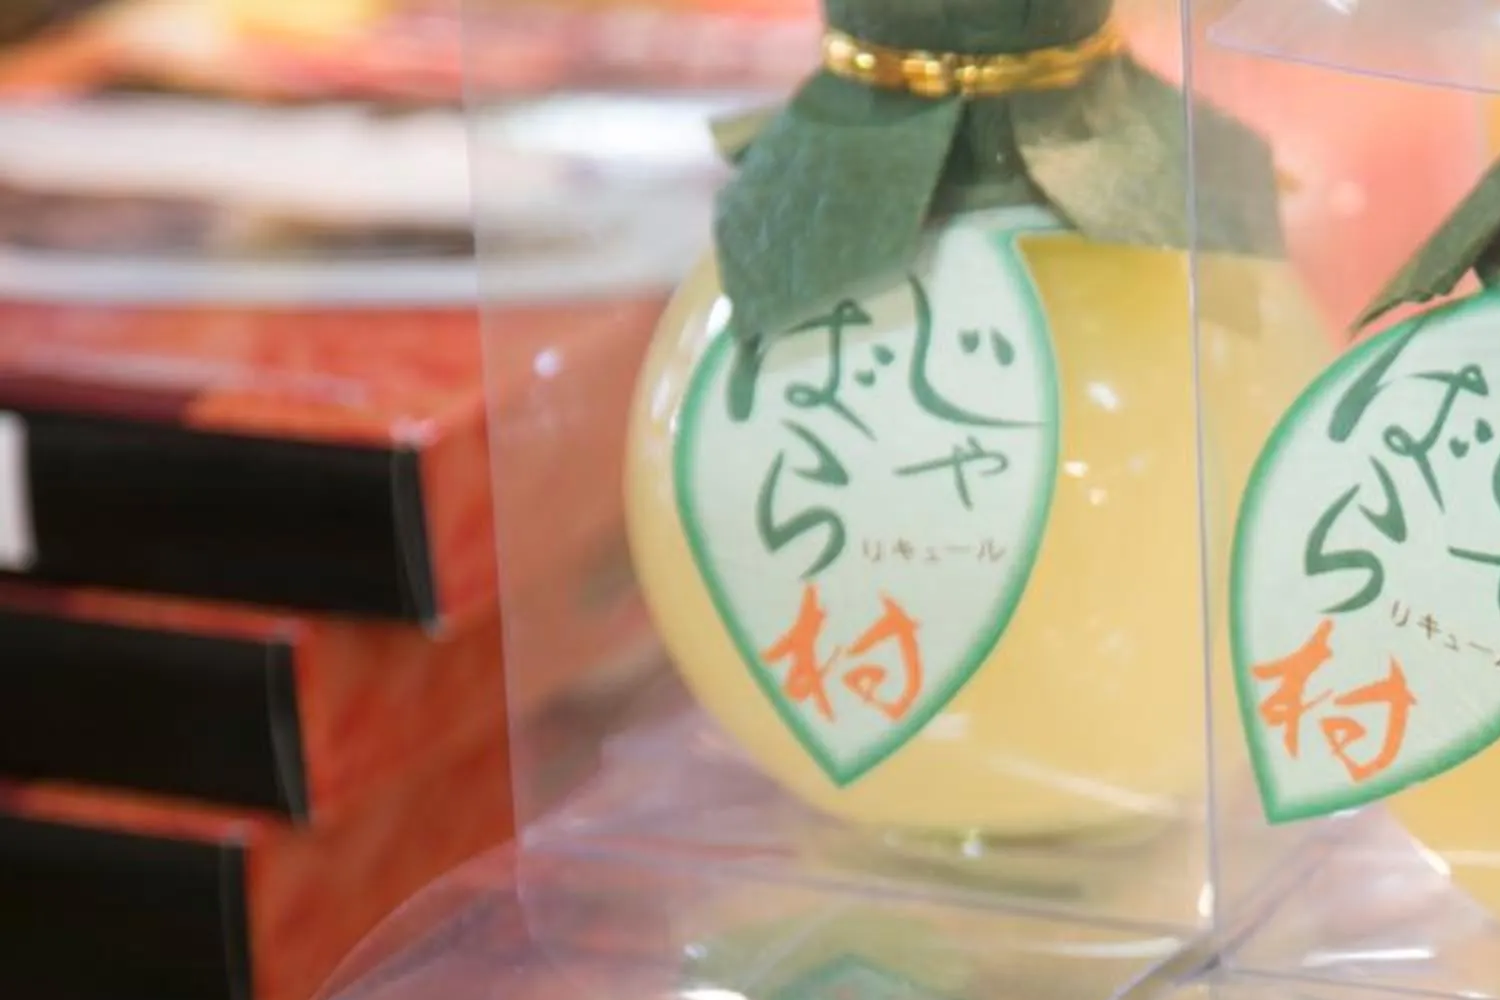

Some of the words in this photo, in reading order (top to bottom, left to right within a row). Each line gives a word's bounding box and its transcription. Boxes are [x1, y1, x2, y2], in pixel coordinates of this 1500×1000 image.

[862, 535, 1007, 564] リキュール
